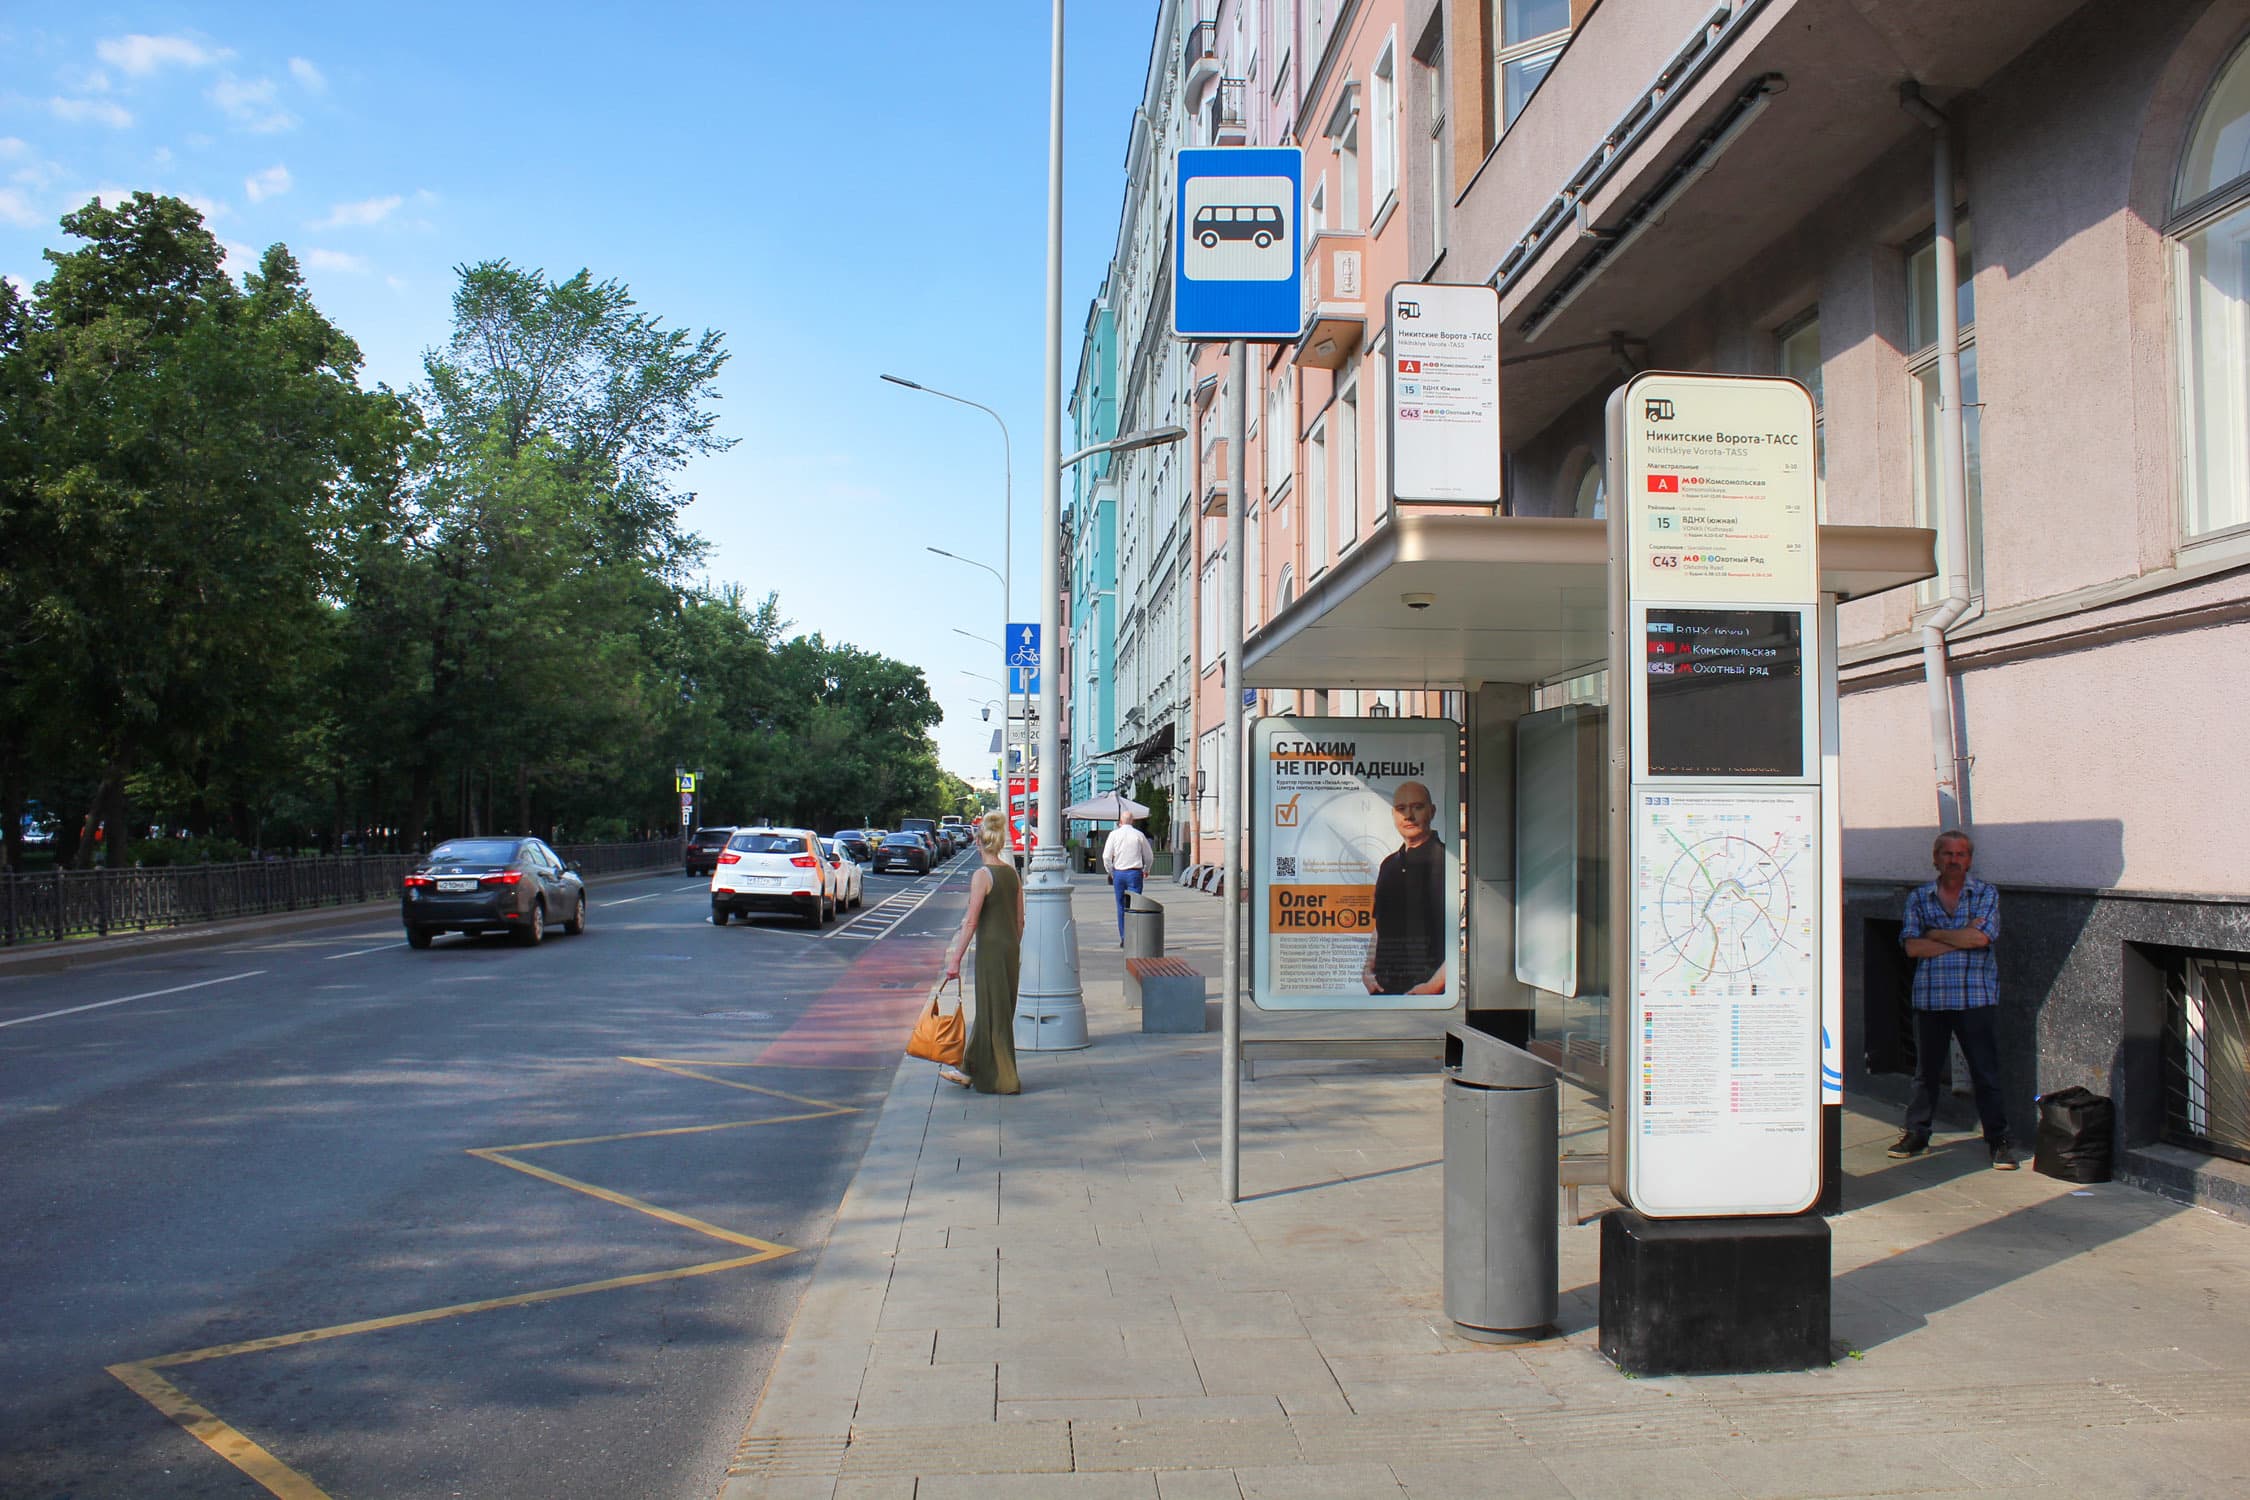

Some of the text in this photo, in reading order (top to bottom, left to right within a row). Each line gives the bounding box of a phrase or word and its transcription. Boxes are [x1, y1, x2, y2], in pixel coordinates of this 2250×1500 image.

[1398, 330, 1438, 339] Никитские
[1440, 331, 1467, 340] Ворота
[1405, 385, 1415, 394] 15
[1646, 430, 1799, 446] Никитские Ворота-ТАСС
[1647, 446, 1749, 457] Nikitskiye Vorota-TASS
[1705, 478, 1766, 486] Комсомольская
[1657, 517, 1671, 529] 15
[1682, 515, 1738, 525] ВДНХ (южная)
[1714, 555, 1749, 563] Охотный
[1750, 556, 1765, 564] Ряд
[1692, 644, 1777, 657] Комсомольская
[1693, 662, 1745, 674] Охотный
[1749, 665, 1770, 676] ряд
[1275, 741, 1356, 757] С ТАКИМ
[1276, 761, 1425, 779] НЕ ПРОПАДЕШЬ!
[1279, 891, 1327, 907] Олег
[1279, 909, 1370, 928] ЛЕОНОВ
